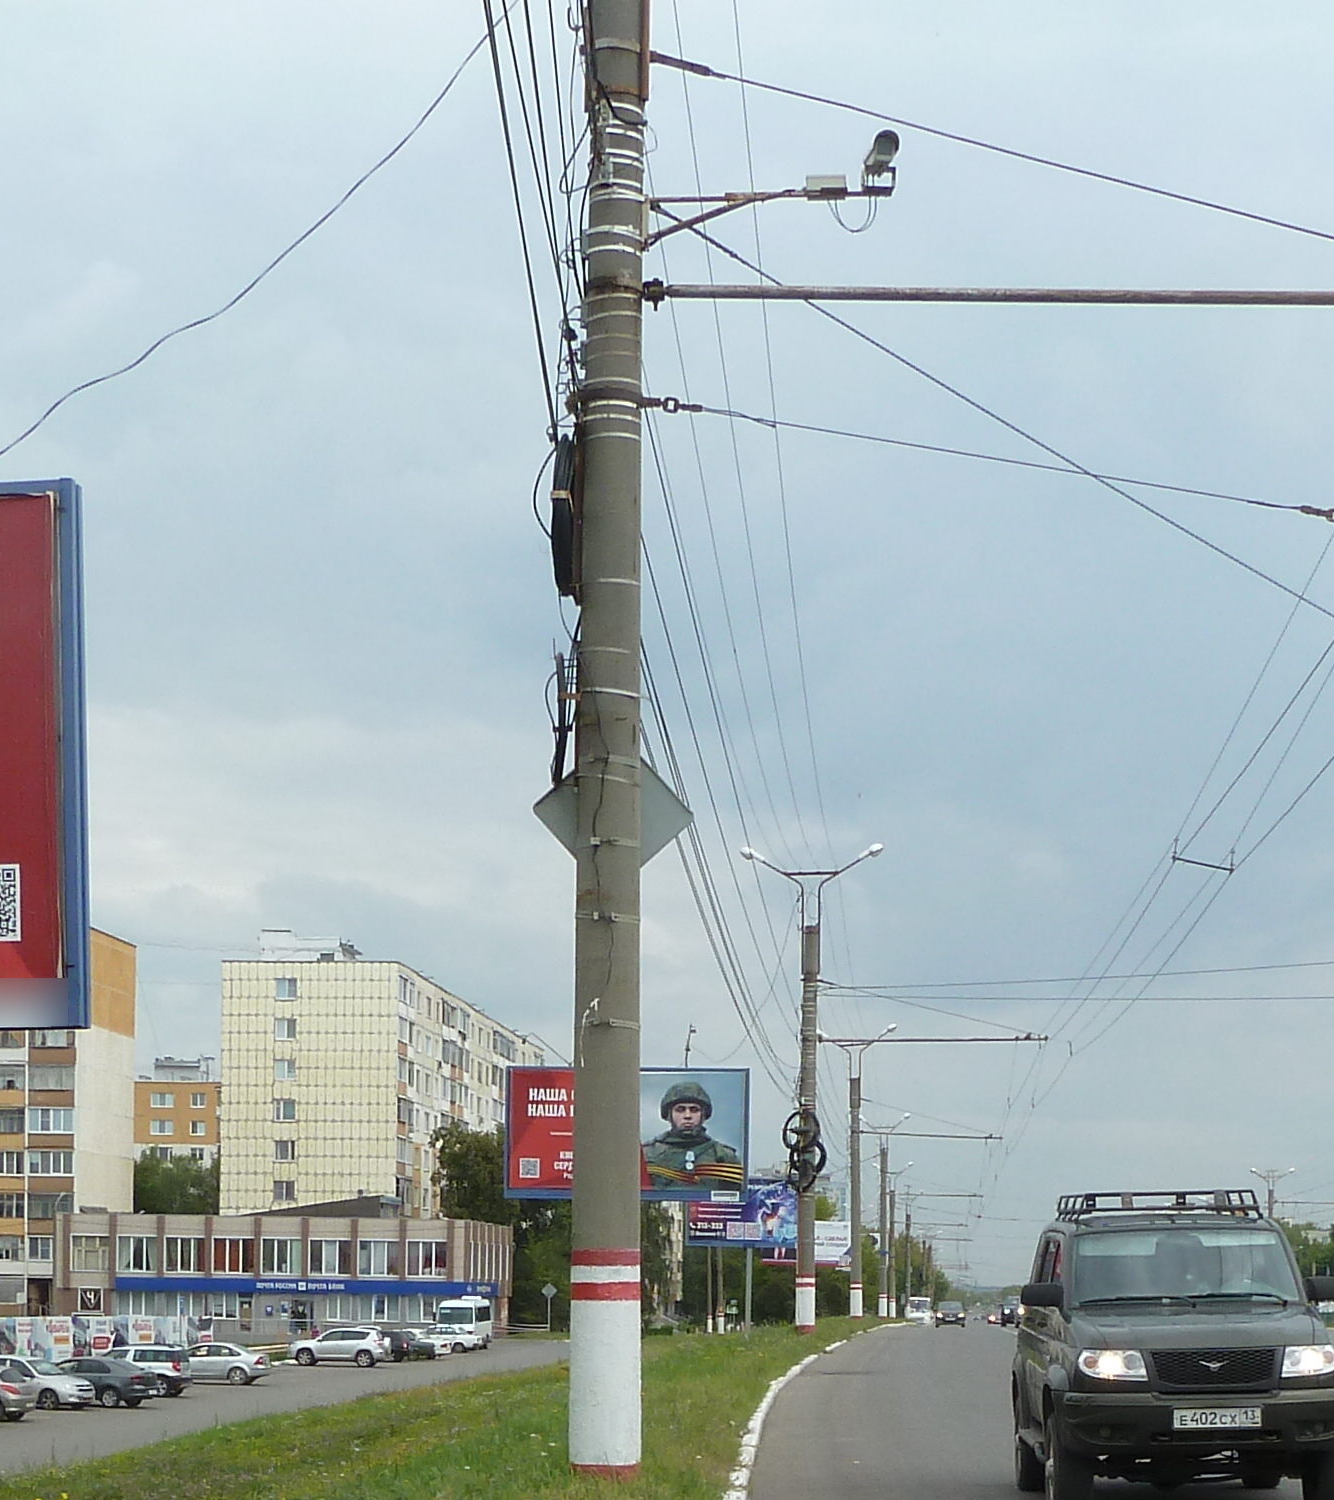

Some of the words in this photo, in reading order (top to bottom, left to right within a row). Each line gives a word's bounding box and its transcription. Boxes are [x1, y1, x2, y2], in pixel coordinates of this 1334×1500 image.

[528, 1088, 568, 1102] НАША
[527, 1104, 566, 1117] НАША
[1179, 1411, 1238, 1427] Е402СХ
[1242, 1409, 1257, 1421] 13
